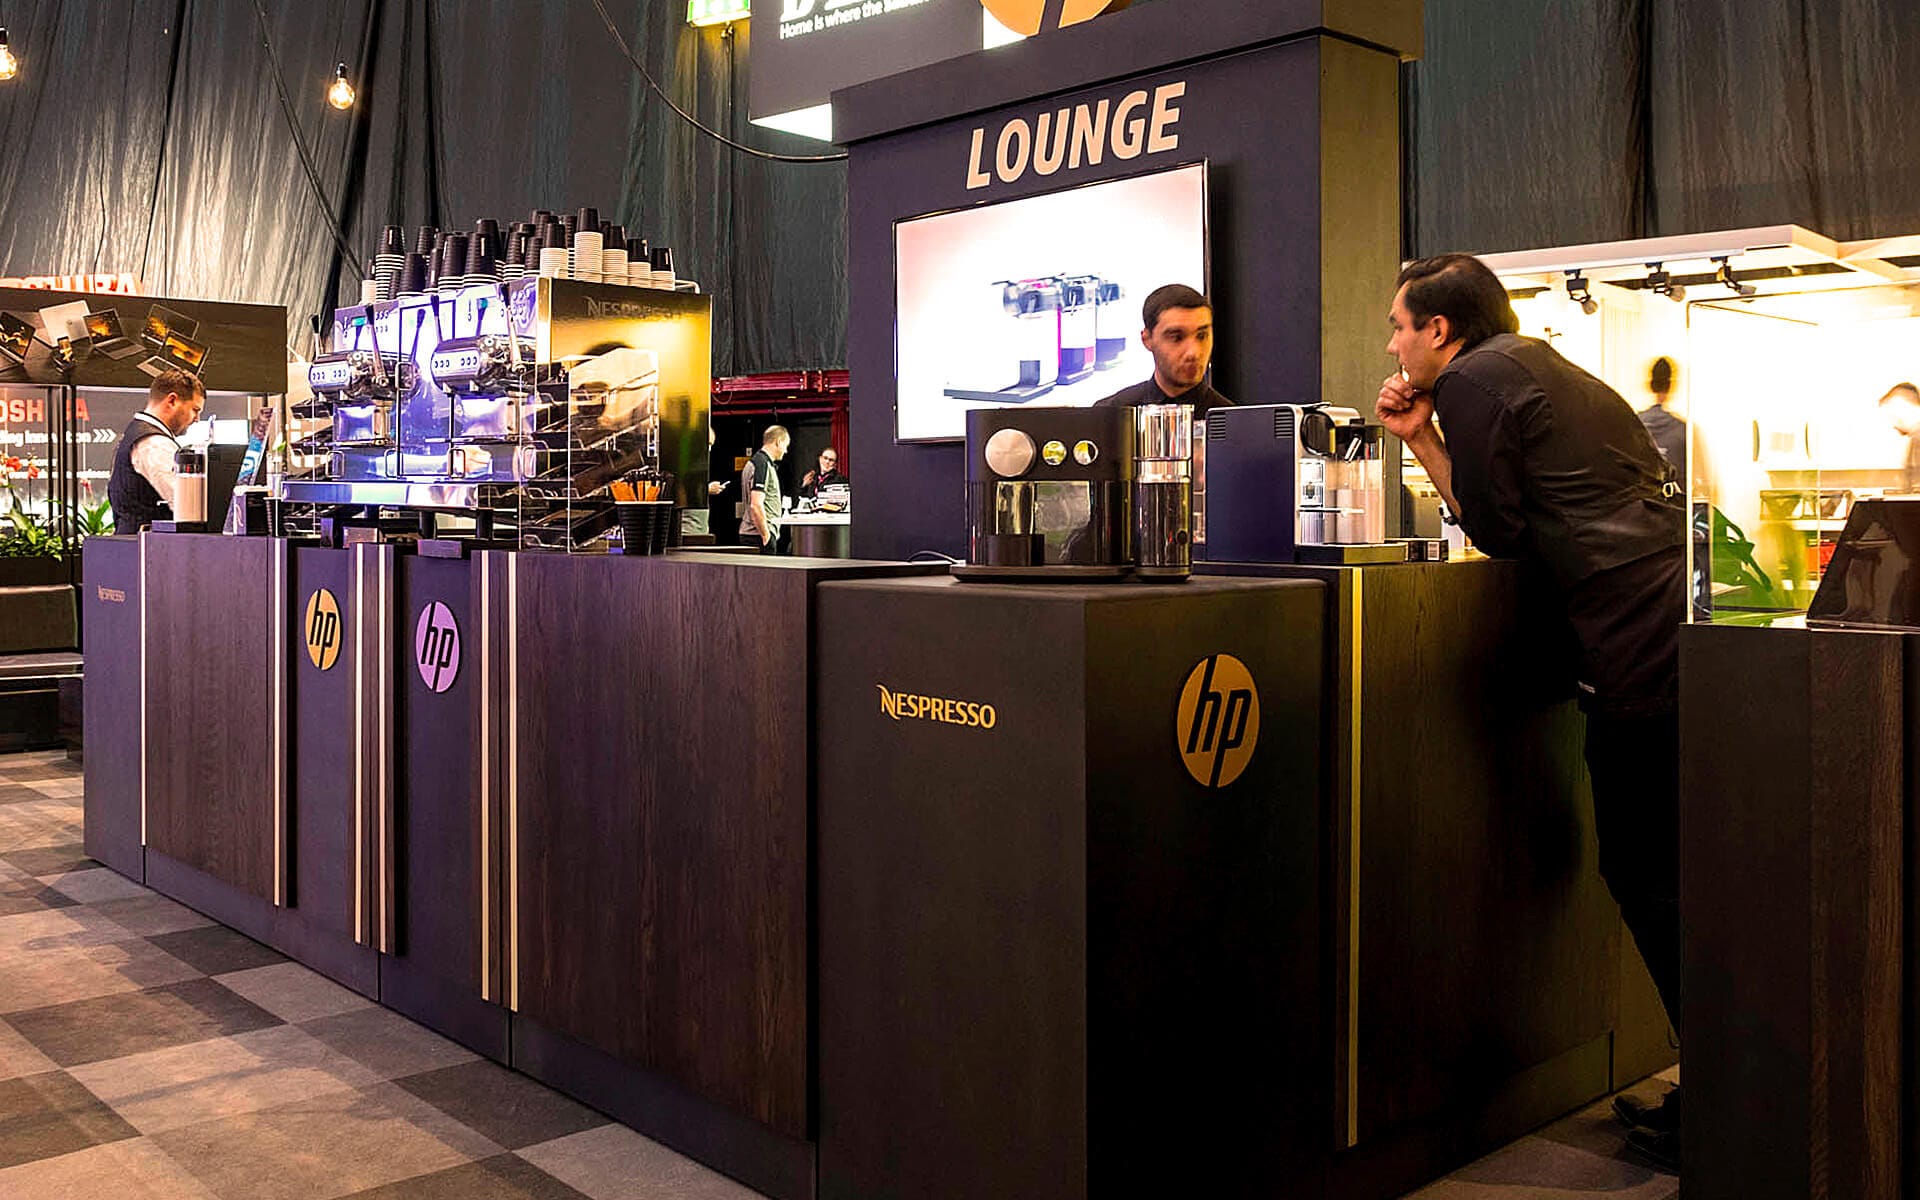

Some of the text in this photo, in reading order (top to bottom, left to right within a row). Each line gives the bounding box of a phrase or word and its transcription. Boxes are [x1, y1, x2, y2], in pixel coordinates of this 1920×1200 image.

[780, 19, 814, 40] Home
[814, 14, 825, 31] is
[825, 6, 861, 28] where
[862, 0, 884, 18] the
[966, 81, 1186, 190] LOUNGE
[307, 588, 338, 670] hp
[418, 601, 457, 693] hp
[876, 684, 996, 730] NESPRESSO
[1182, 654, 1255, 788] hp
